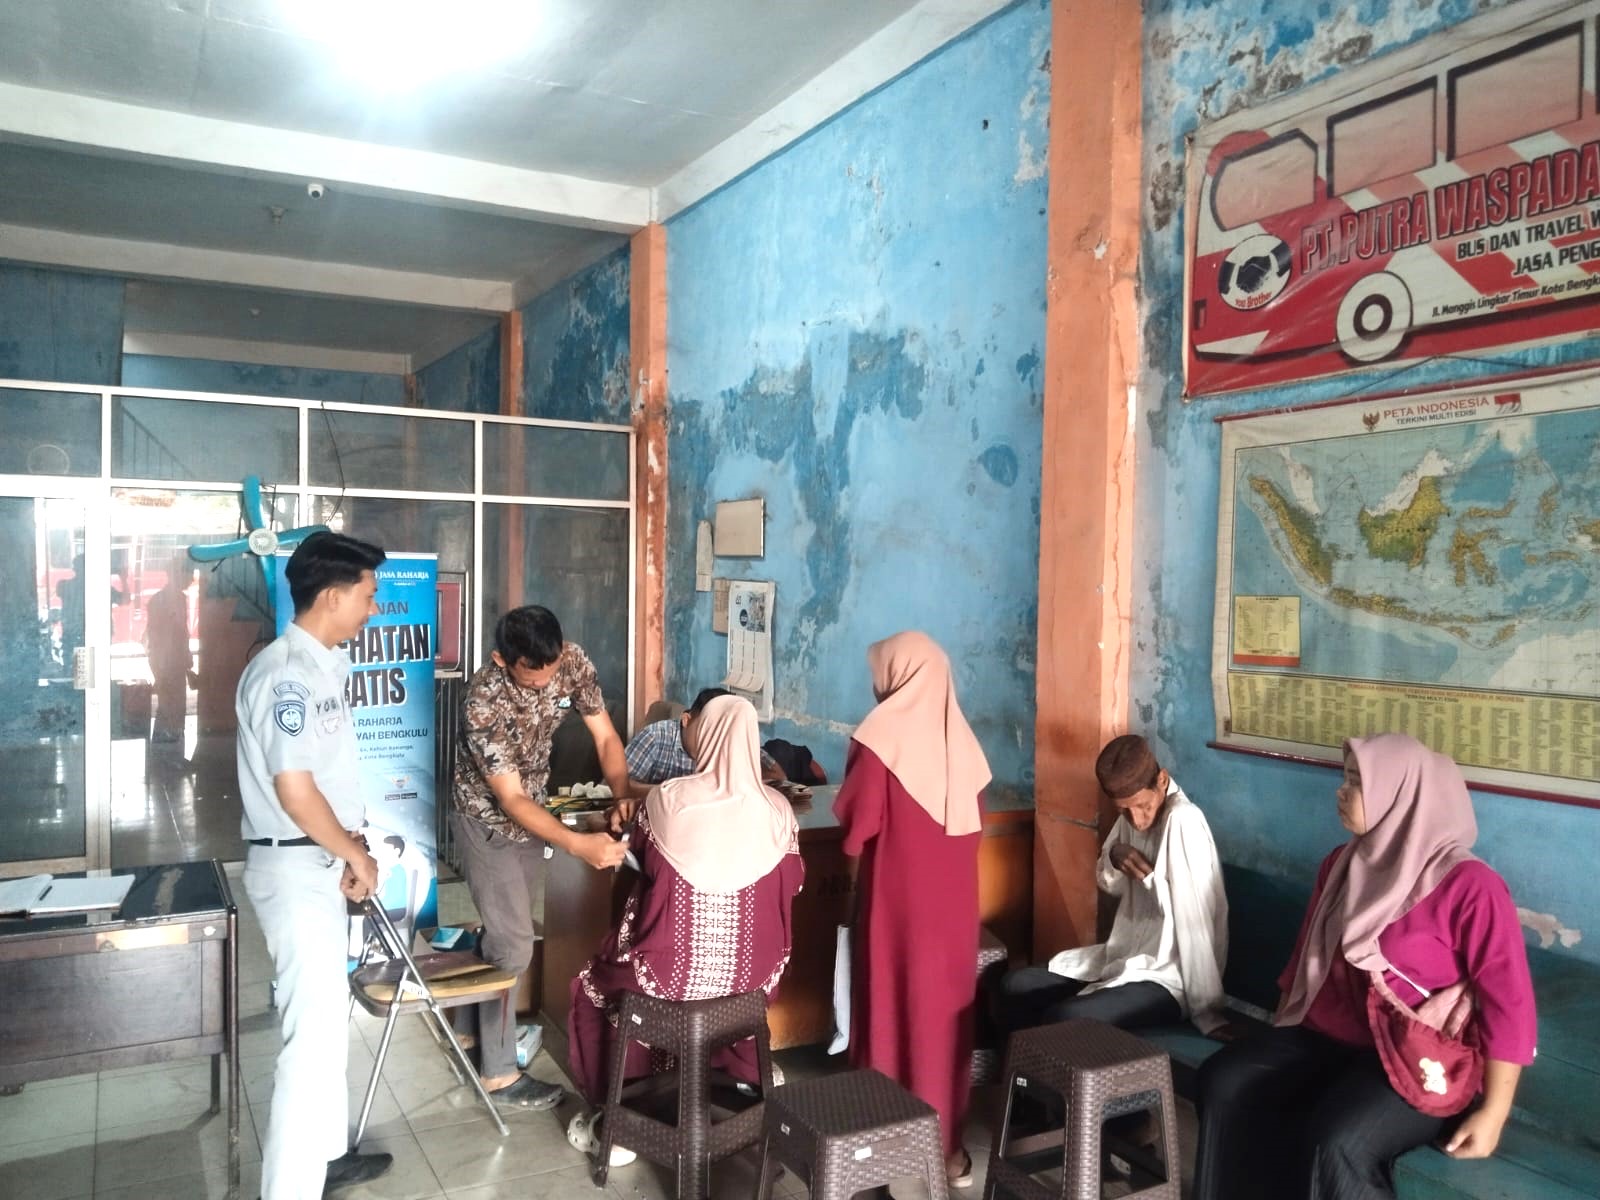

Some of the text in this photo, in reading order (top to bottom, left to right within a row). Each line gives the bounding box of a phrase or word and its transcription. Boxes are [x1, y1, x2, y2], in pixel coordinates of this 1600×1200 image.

[1339, 190, 1432, 264] PUTRA
[1434, 139, 1600, 240] WASPADA
[1457, 238, 1485, 260] BUS
[1489, 230, 1521, 252] DAN
[1526, 214, 1585, 244] TRAVEL
[1513, 253, 1553, 275] JASA
[1441, 299, 1476, 316] Manggis
[1512, 287, 1539, 300] Timur
[1566, 276, 1600, 292] Bengk
[1383, 397, 1490, 419] PETA INDONESIA
[1396, 409, 1477, 425] TERKINI MULTI EDISI
[380, 570, 430, 580] JASA RAHARJA
[357, 716, 403, 727] RAHARJA
[377, 727, 428, 740] BENGKULU
